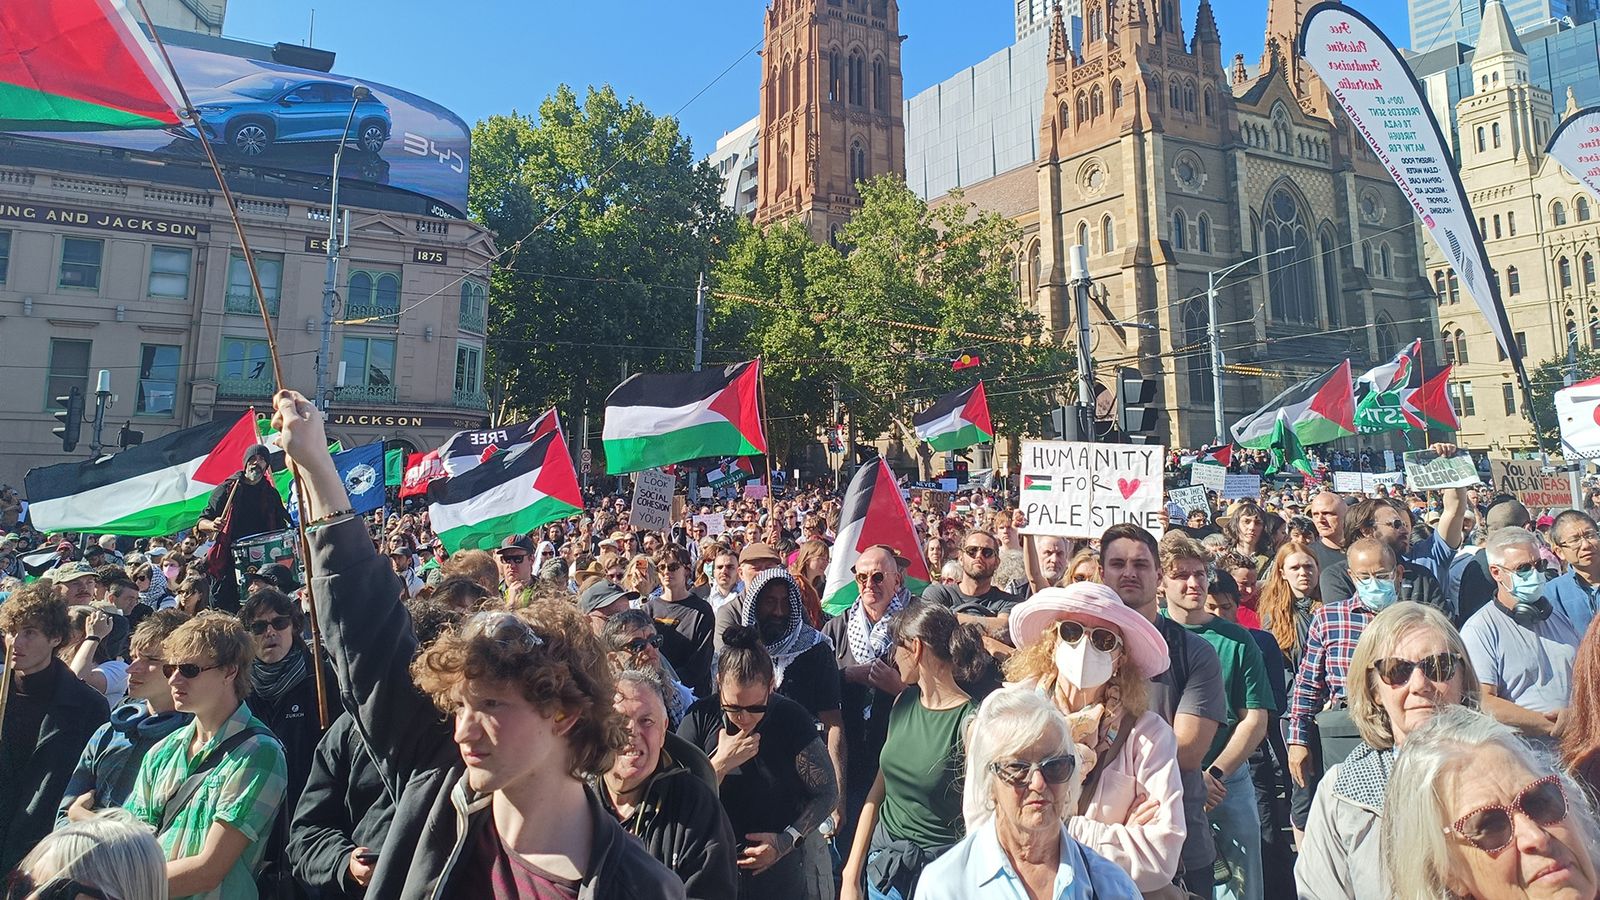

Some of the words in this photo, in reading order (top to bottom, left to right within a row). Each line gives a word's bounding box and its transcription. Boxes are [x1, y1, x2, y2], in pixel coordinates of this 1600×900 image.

[404, 131, 464, 174] BYD
[46, 210, 89, 224] AND
[97, 216, 197, 236] JACKSON
[310, 239, 329, 250] ES
[417, 251, 443, 262] 1875
[334, 415, 422, 426] JACKSON
[1033, 446, 1153, 476] HUMANITY
[1409, 465, 1423, 476] WE
[1501, 461, 1525, 476] YOU
[644, 477, 668, 488] LOOK
[1062, 474, 1112, 492] FOR
[1501, 475, 1570, 491] ALBANEASY
[924, 491, 948, 502] STOP
[1171, 489, 1189, 498] BRING
[1190, 487, 1203, 495] THIS
[1523, 492, 1541, 506] WAR
[1174, 495, 1206, 506] POWER
[639, 512, 665, 526] YOU?!
[1026, 502, 1161, 529] PALESTINE
